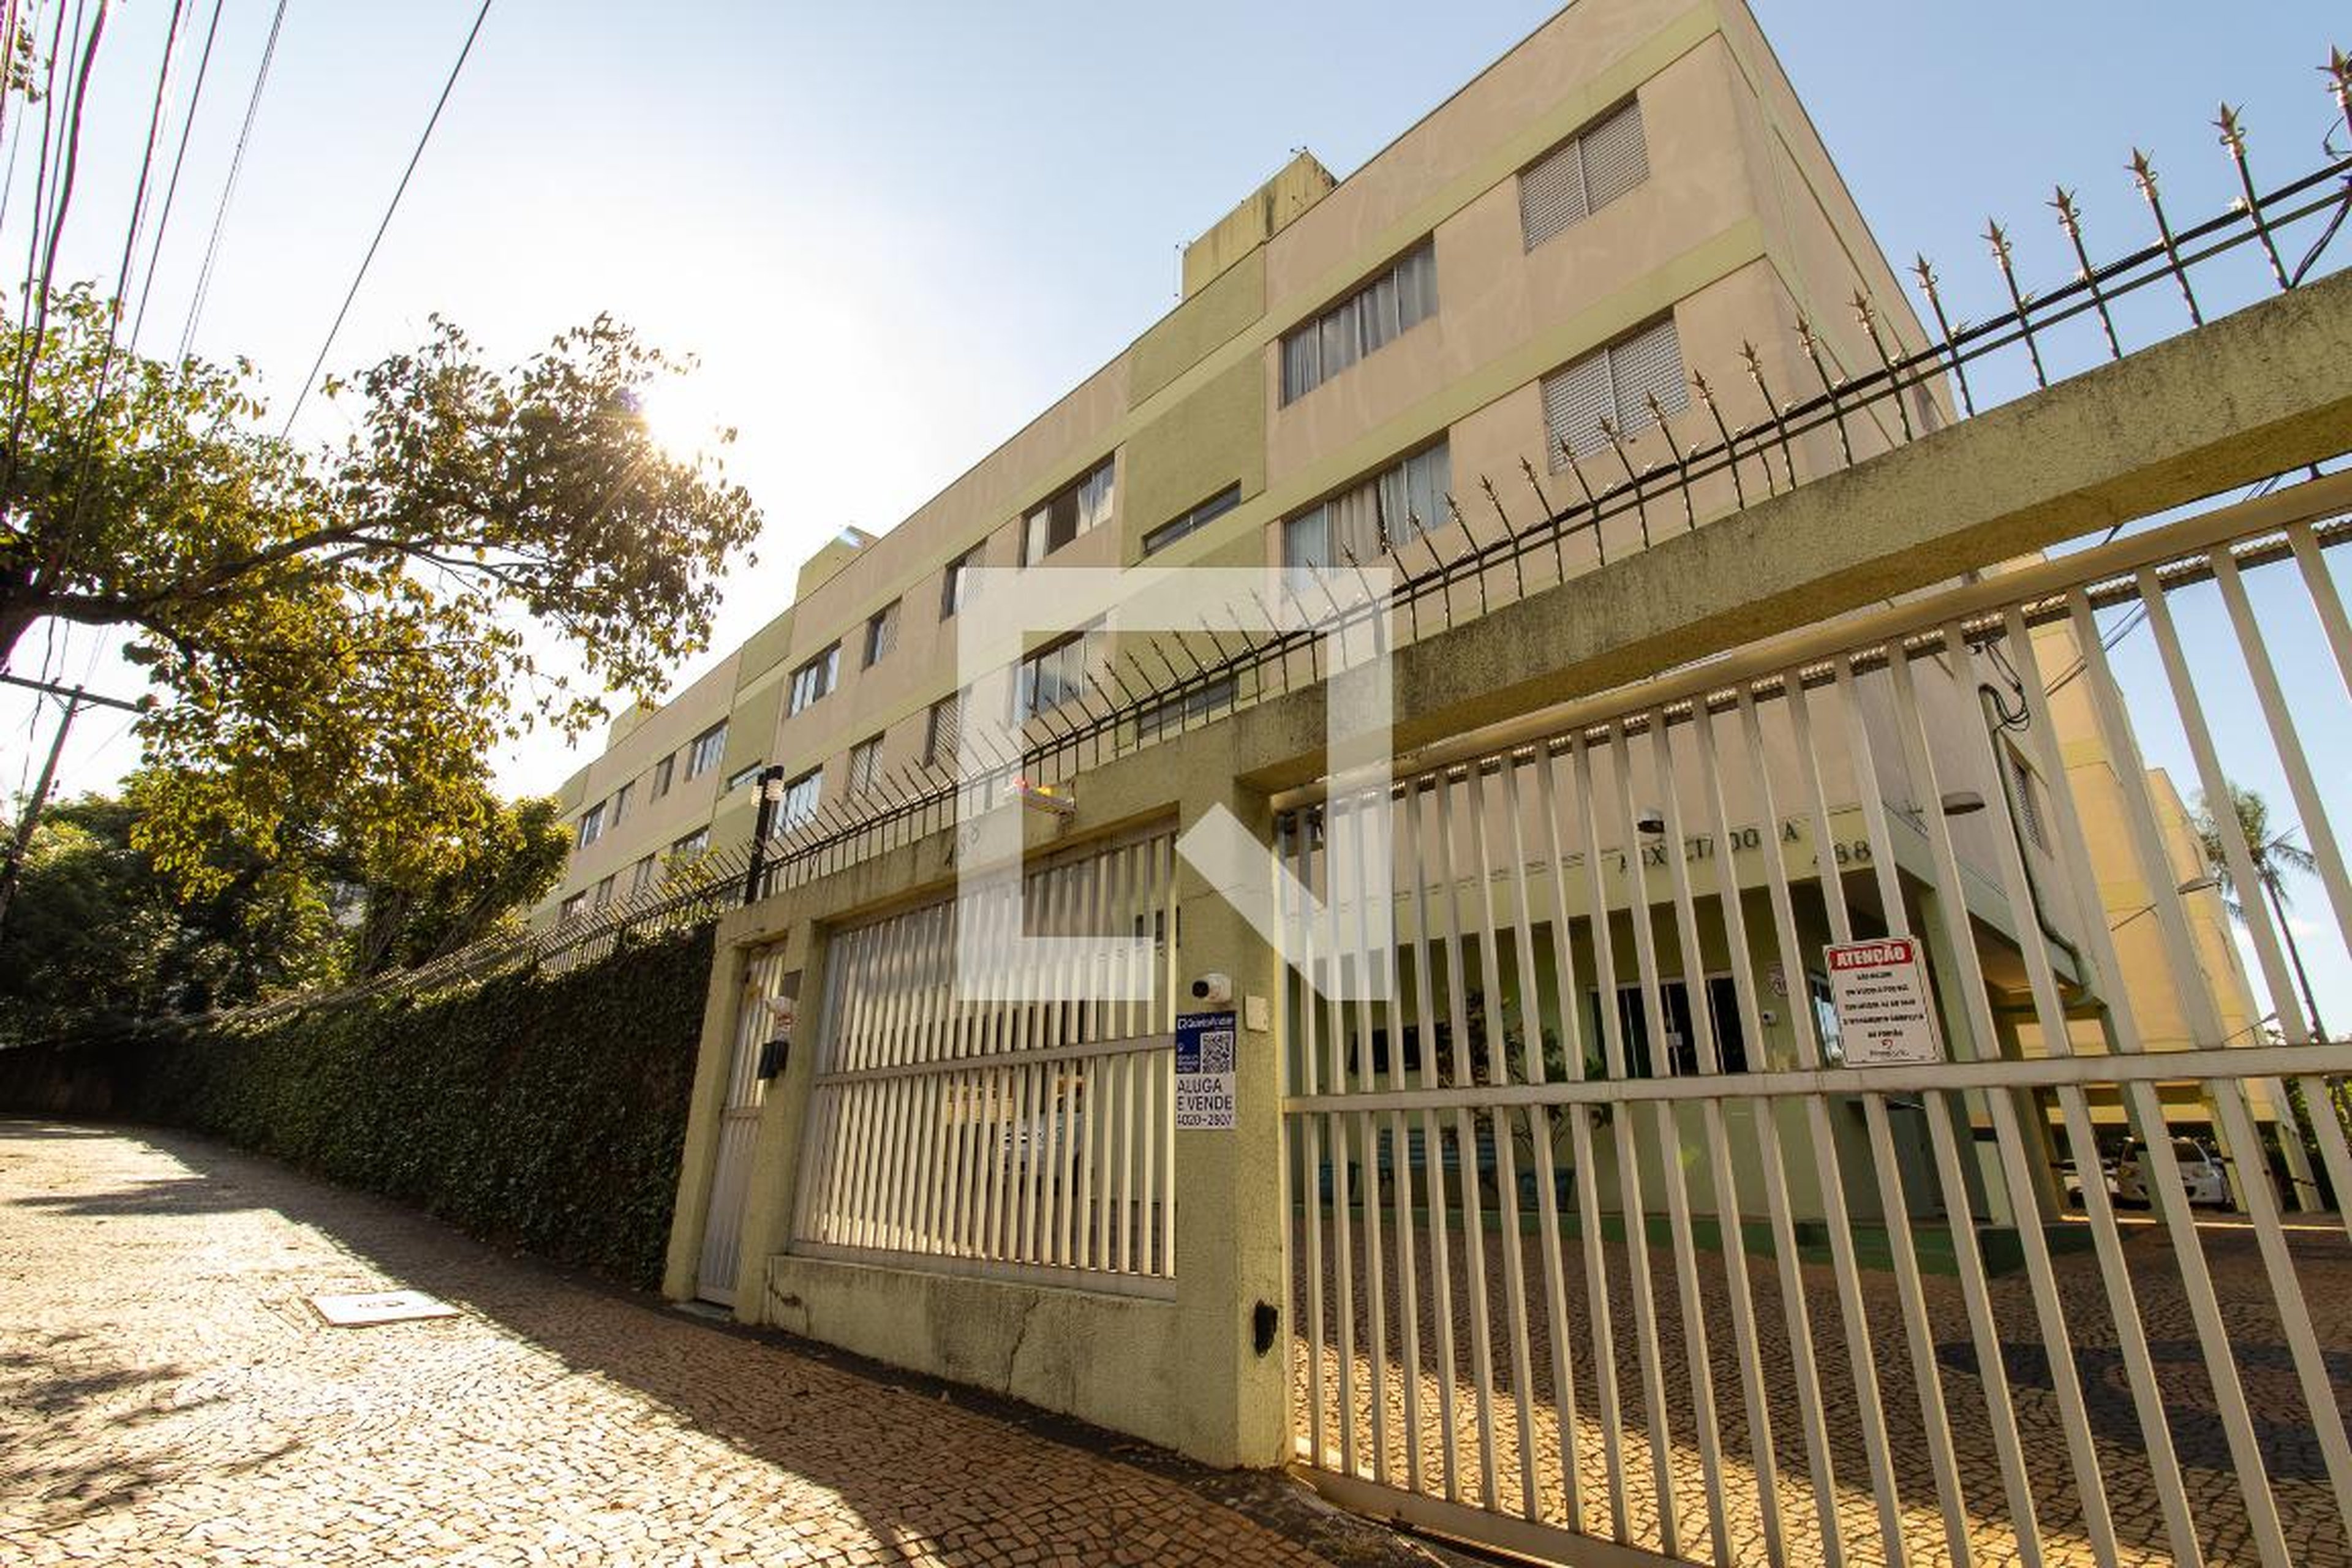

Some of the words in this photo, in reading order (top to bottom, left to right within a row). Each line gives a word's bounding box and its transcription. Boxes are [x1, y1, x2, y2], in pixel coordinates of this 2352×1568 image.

[1837, 944, 1905, 967] ATENÇÃO
[1177, 1078, 1223, 1093] ALUGA
[1177, 1096, 1183, 1110] E
[1187, 1095, 1232, 1110] VENDE
